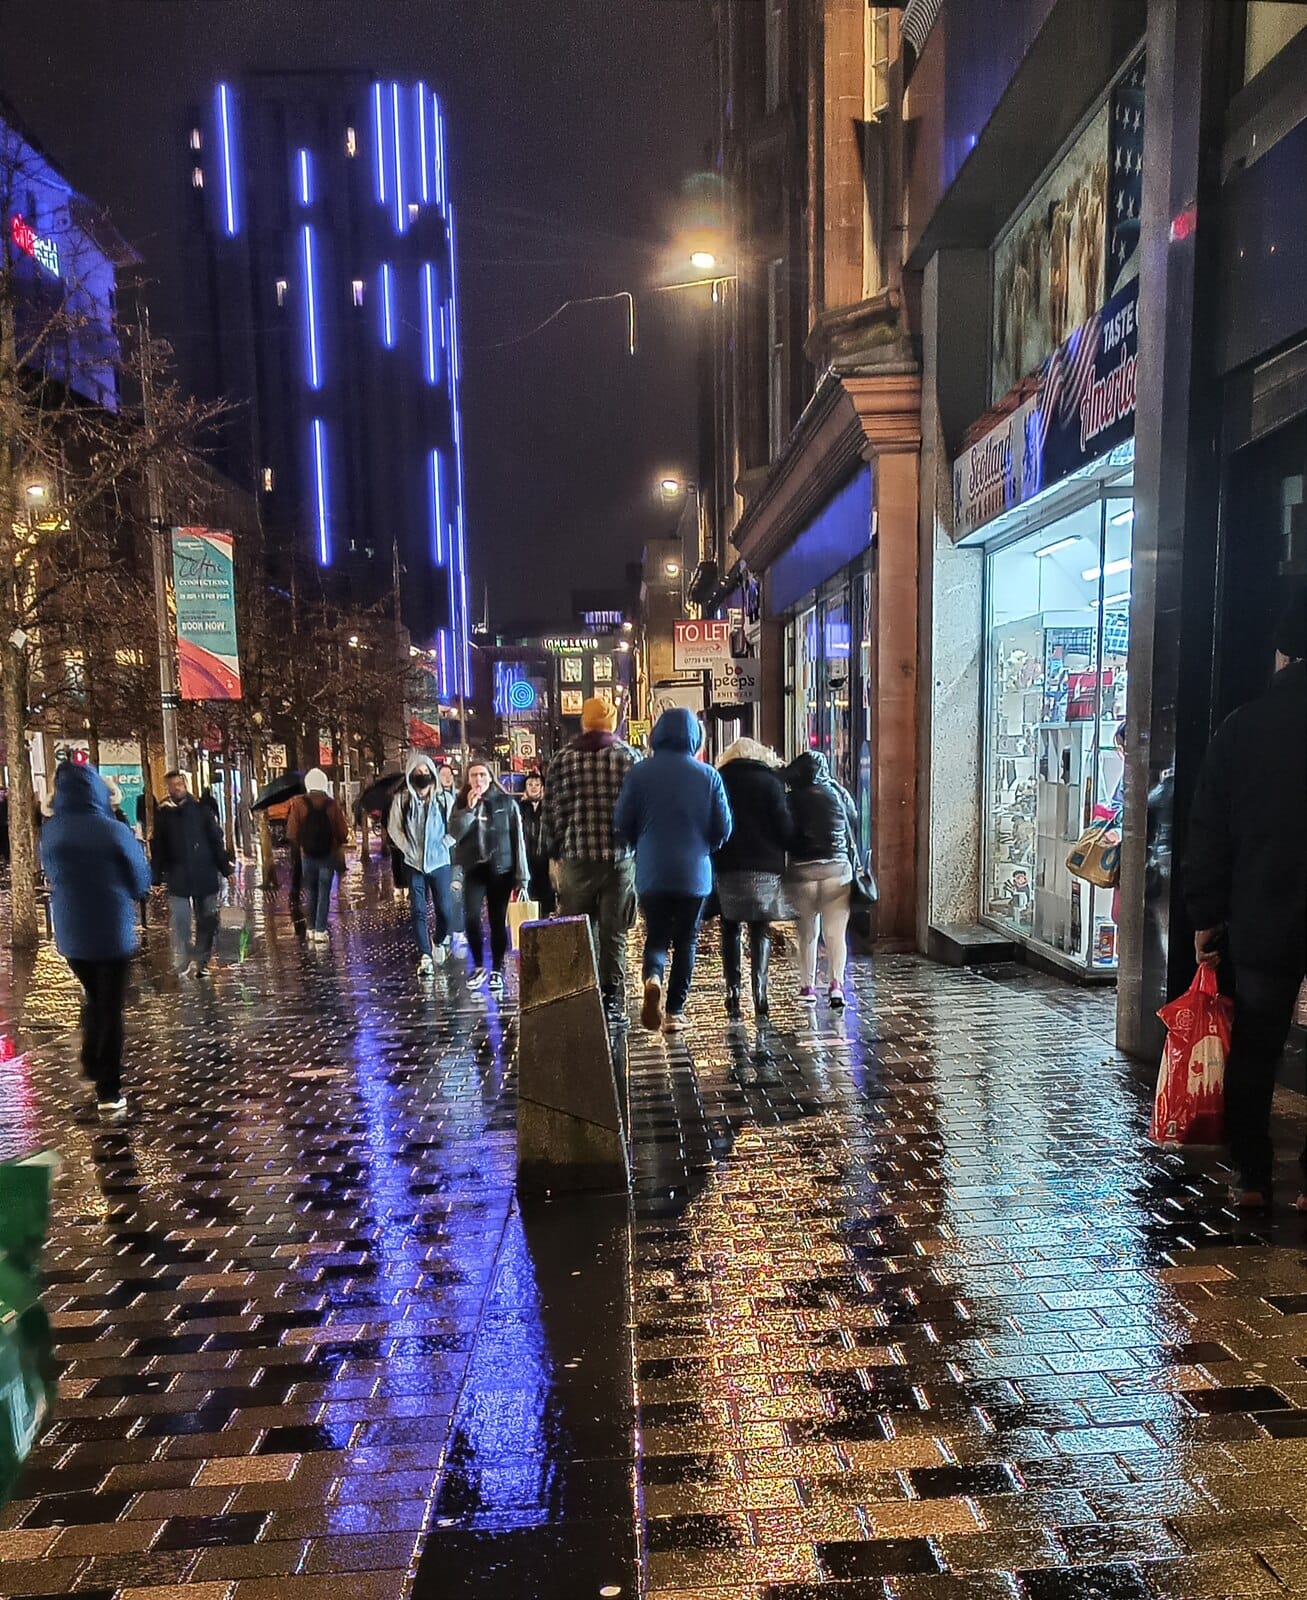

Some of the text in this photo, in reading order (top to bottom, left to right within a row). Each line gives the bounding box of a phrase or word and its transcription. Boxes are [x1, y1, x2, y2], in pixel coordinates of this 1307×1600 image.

[1103, 301, 1134, 353] TASTE
[968, 419, 1013, 500] Scotland
[181, 621, 225, 631] BOOK NOW
[675, 622, 729, 643] TO LET
[713, 675, 755, 691] peep's
[717, 690, 752, 698] KNITWEAR
